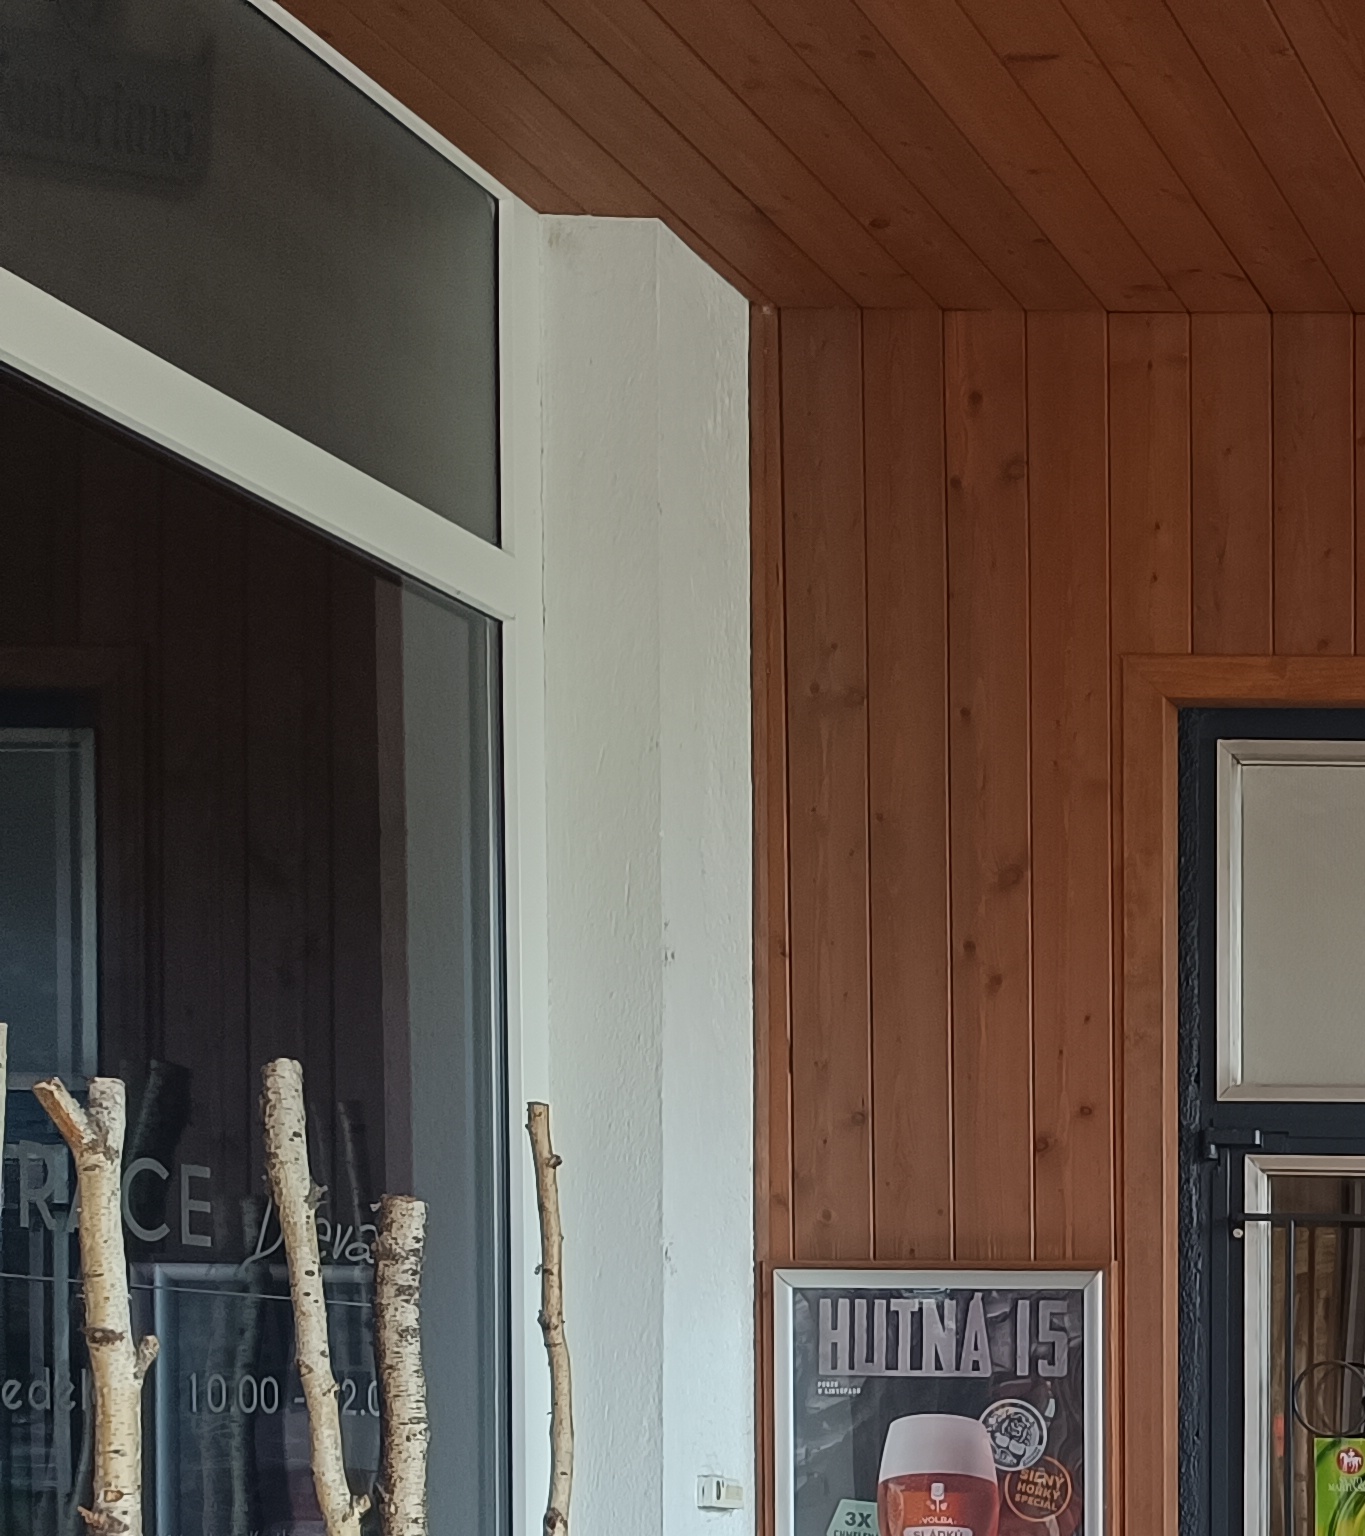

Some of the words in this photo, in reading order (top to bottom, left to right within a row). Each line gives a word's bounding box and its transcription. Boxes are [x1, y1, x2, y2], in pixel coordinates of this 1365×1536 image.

[18, 1138, 213, 1248] RCE
[816, 1291, 992, 1377] HUTNÁ
[1015, 1298, 1069, 1377] 15
[844, 1511, 873, 1529] 3X
